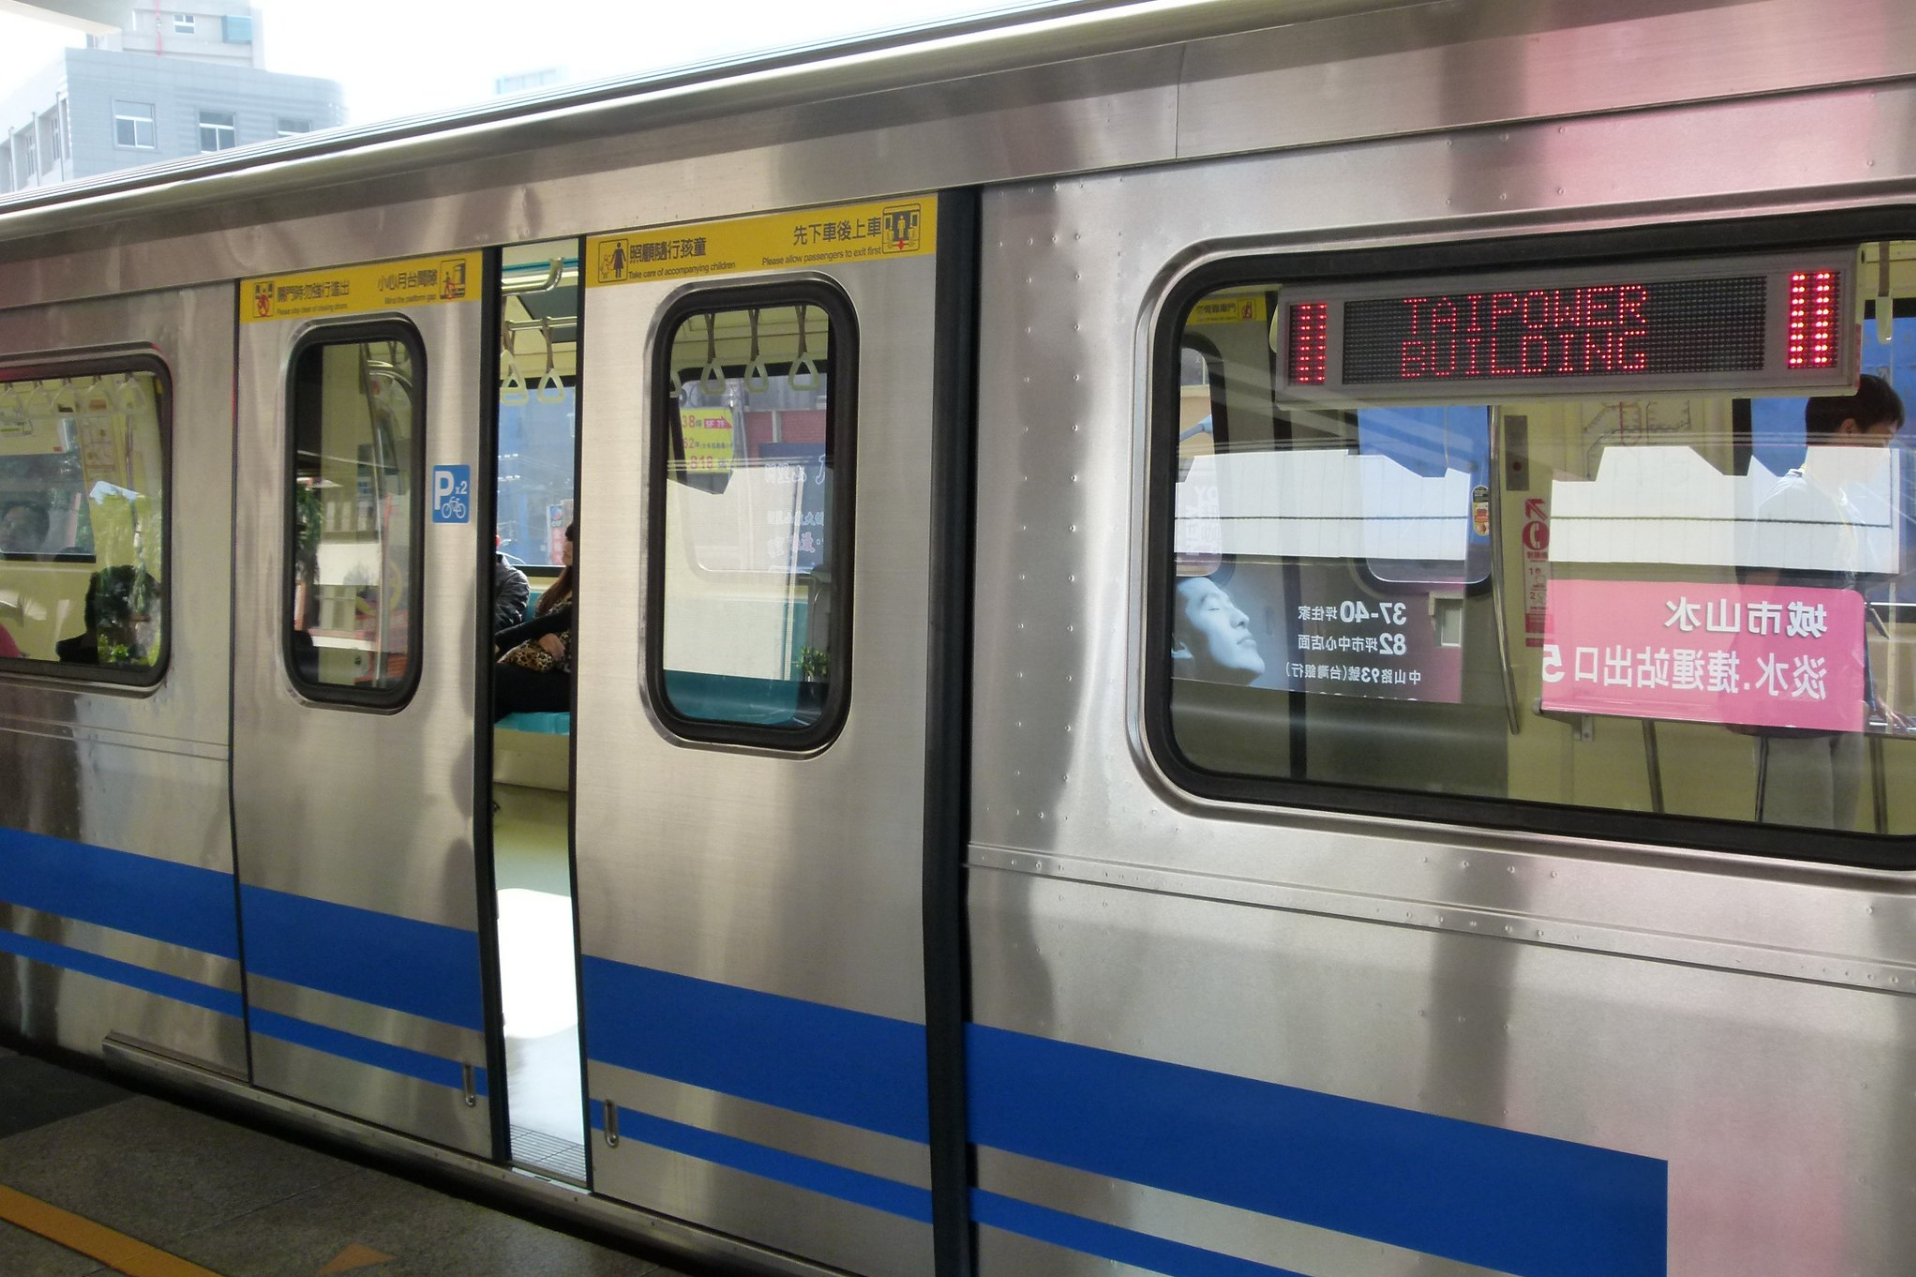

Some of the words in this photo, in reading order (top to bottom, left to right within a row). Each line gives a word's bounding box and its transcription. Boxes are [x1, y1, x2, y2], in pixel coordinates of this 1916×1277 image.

[793, 216, 882, 246] 先下車後上車
[630, 237, 706, 264] 照顧隨行孩童
[762, 256, 784, 266] Please
[785, 254, 802, 264] allow
[804, 251, 844, 264] passengers
[845, 249, 852, 258] to
[854, 248, 866, 257] exit
[867, 246, 882, 255] first
[629, 271, 642, 279] Take
[643, 270, 656, 278] care
[657, 268, 664, 276] of
[664, 264, 710, 277] accompanying
[710, 261, 736, 271] children
[1402, 285, 1648, 335] TAIPOWER
[1401, 330, 1647, 378] BUILDING
[434, 470, 454, 510] P
